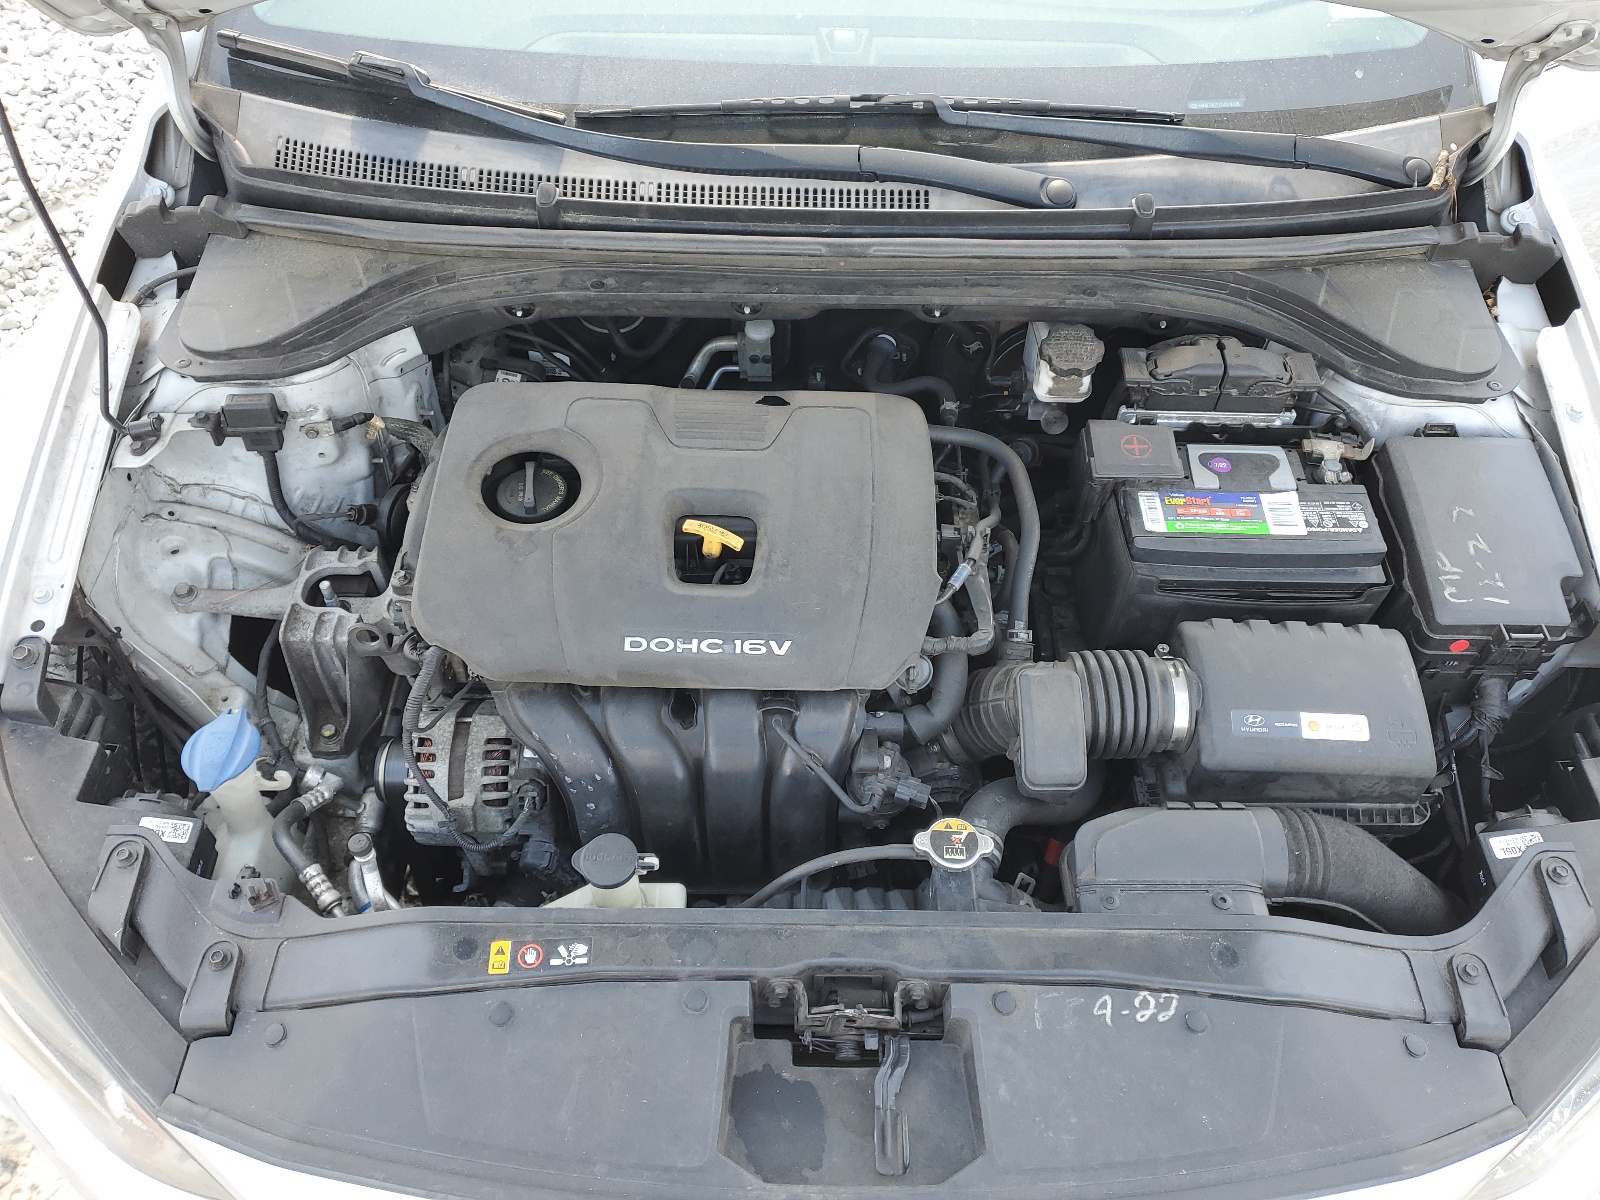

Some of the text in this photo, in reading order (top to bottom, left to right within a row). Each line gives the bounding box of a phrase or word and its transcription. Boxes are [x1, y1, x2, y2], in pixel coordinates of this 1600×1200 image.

[1164, 496, 1212, 506] EverStart
[622, 636, 794, 657] DOHC 16V
